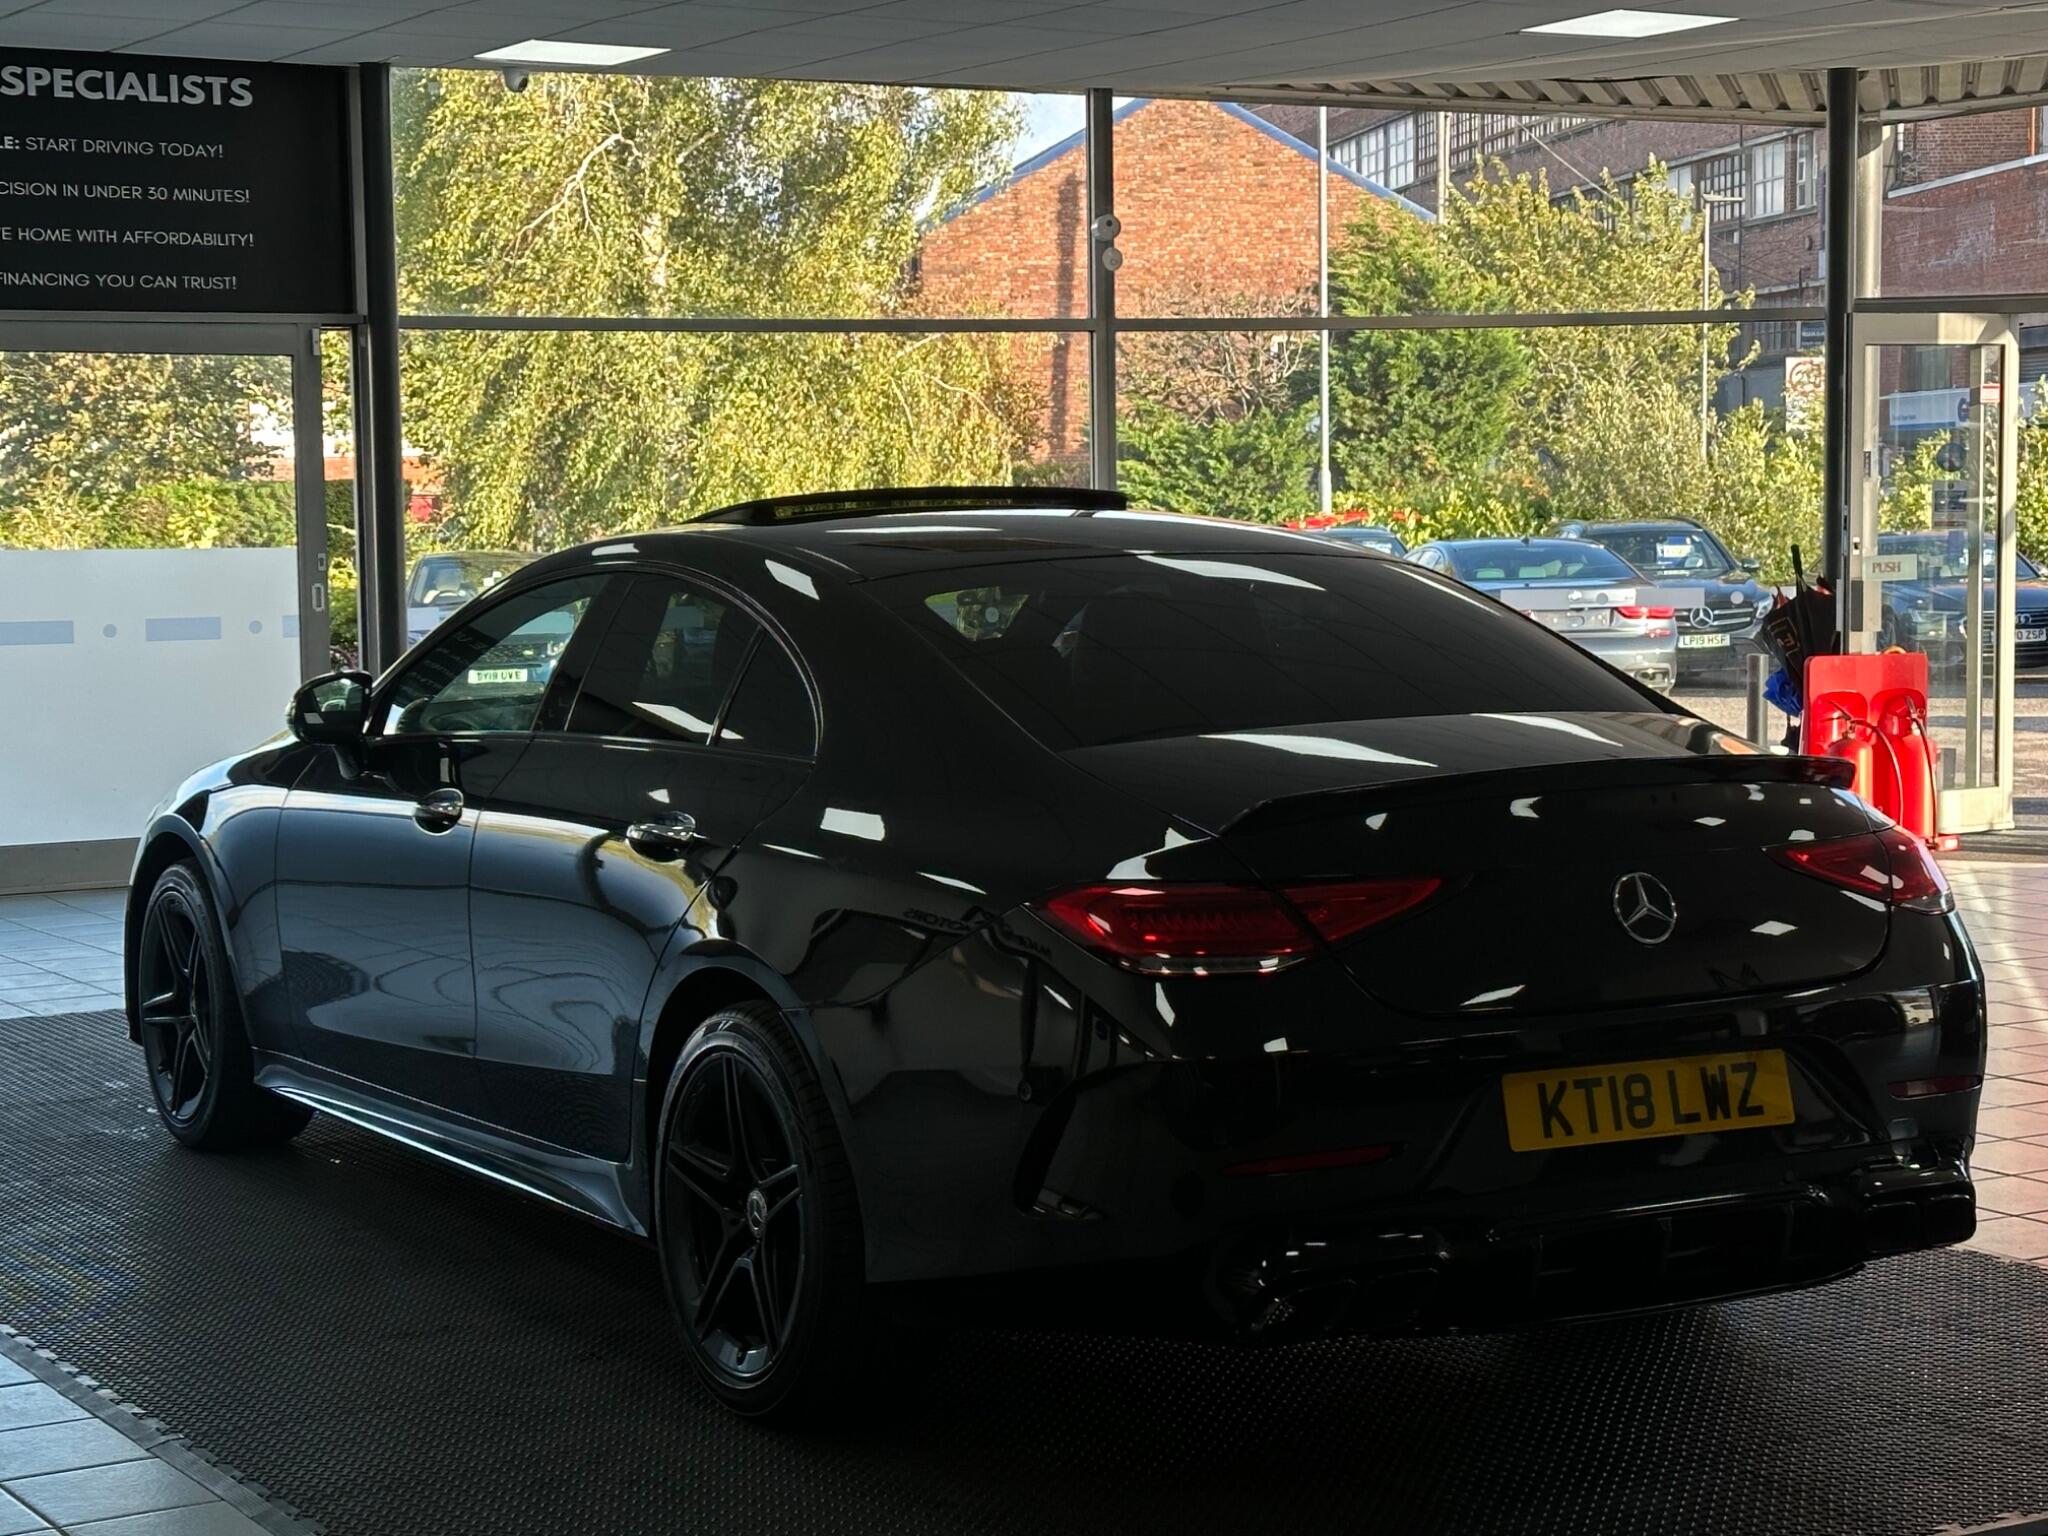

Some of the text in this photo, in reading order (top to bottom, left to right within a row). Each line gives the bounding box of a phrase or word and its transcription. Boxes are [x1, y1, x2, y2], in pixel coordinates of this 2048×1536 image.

[0, 65, 253, 107] SPECIALISTS
[25, 136, 77, 152] START
[82, 139, 154, 155] DRIVING
[158, 142, 223, 158] TODAY!
[62, 183, 79, 197] IN
[83, 184, 142, 199] UNDER
[147, 186, 168, 200] 30
[172, 188, 250, 203] MINUTES!
[0, 226, 255, 247] E HOME WITH AFFORDABILITY!
[94, 274, 135, 288] YOU
[139, 275, 177, 289] CAN
[182, 276, 237, 290] TRUST!
[1872, 561, 1901, 573] PUSH
[1537, 1061, 1765, 1139] KT18 LWZ
